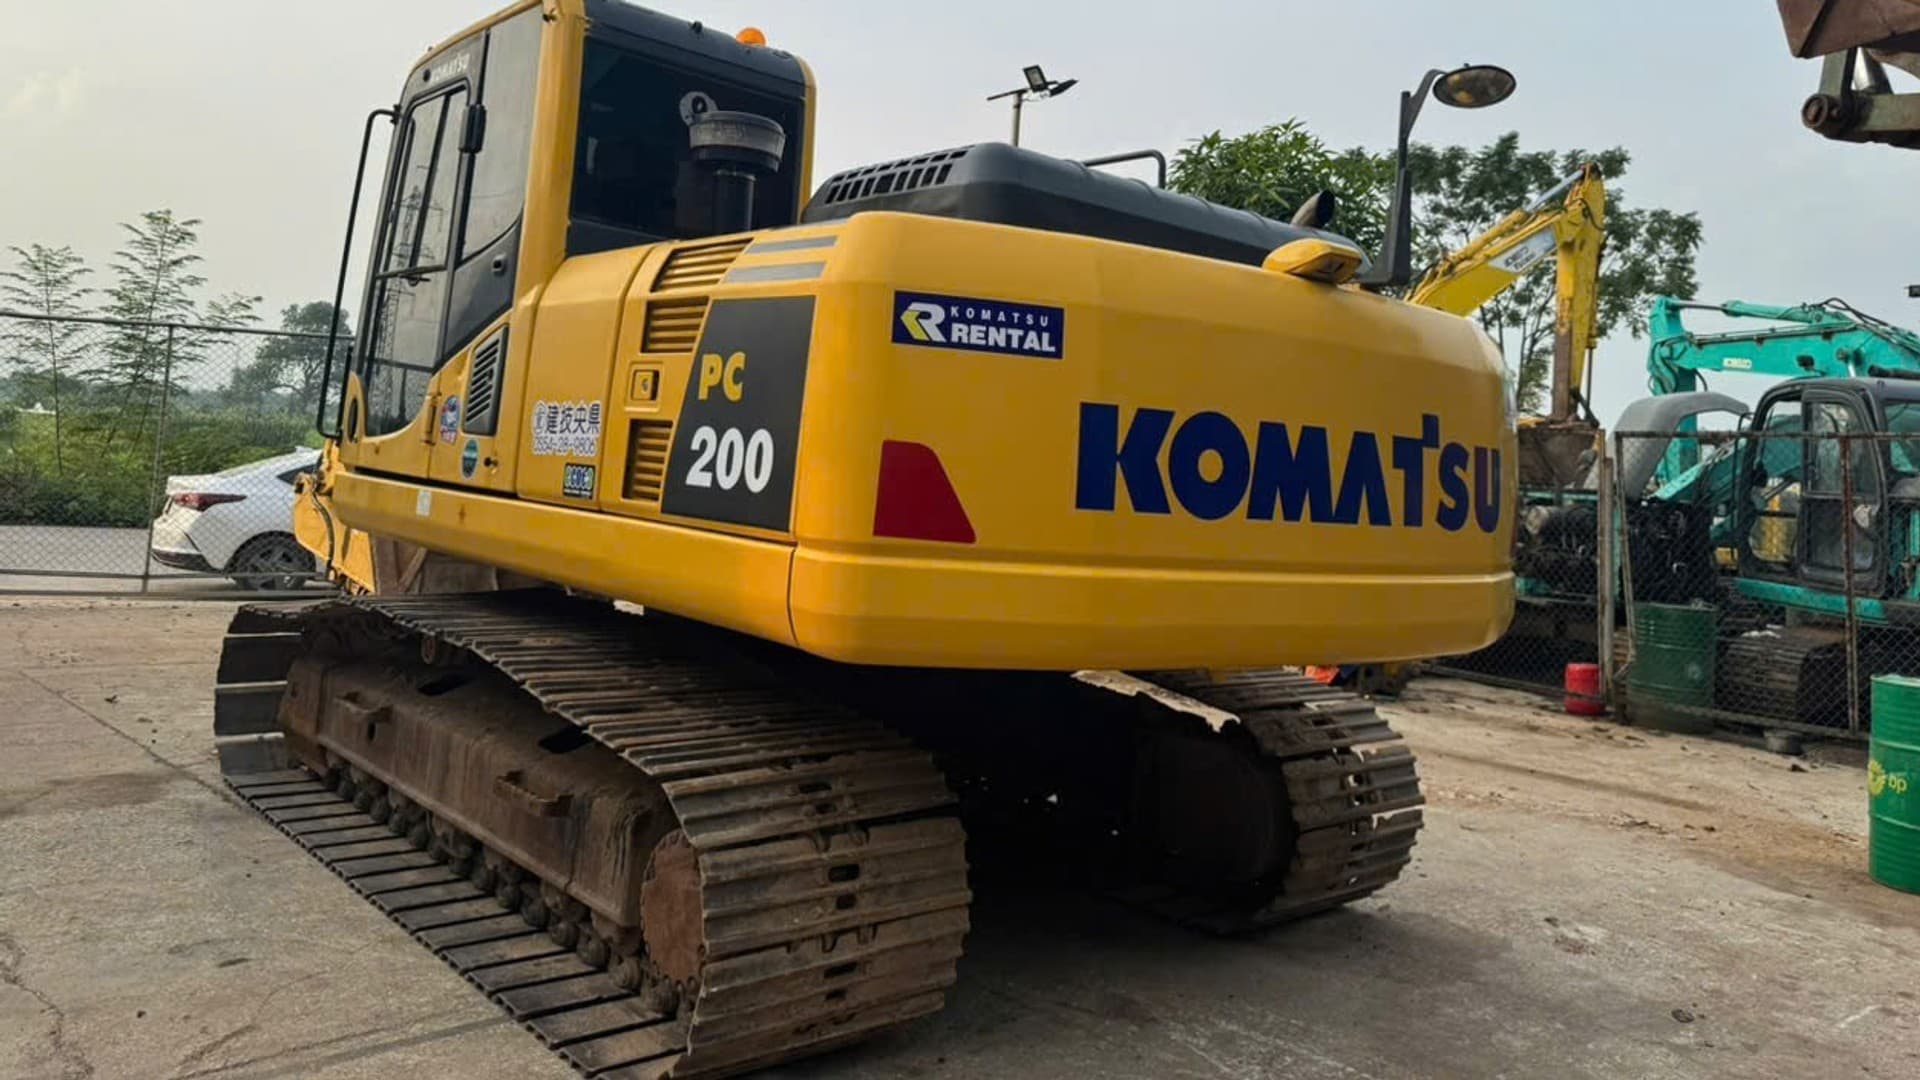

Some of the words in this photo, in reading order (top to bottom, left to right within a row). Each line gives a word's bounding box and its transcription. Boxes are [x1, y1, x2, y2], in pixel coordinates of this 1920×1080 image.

[951, 306, 1048, 327] KOMATSU
[951, 323, 1055, 352] RENTAL
[698, 352, 746, 402] PC
[685, 425, 774, 494] 200
[1075, 402, 1499, 533] KOMATSU
[1888, 773, 1907, 795] bp
